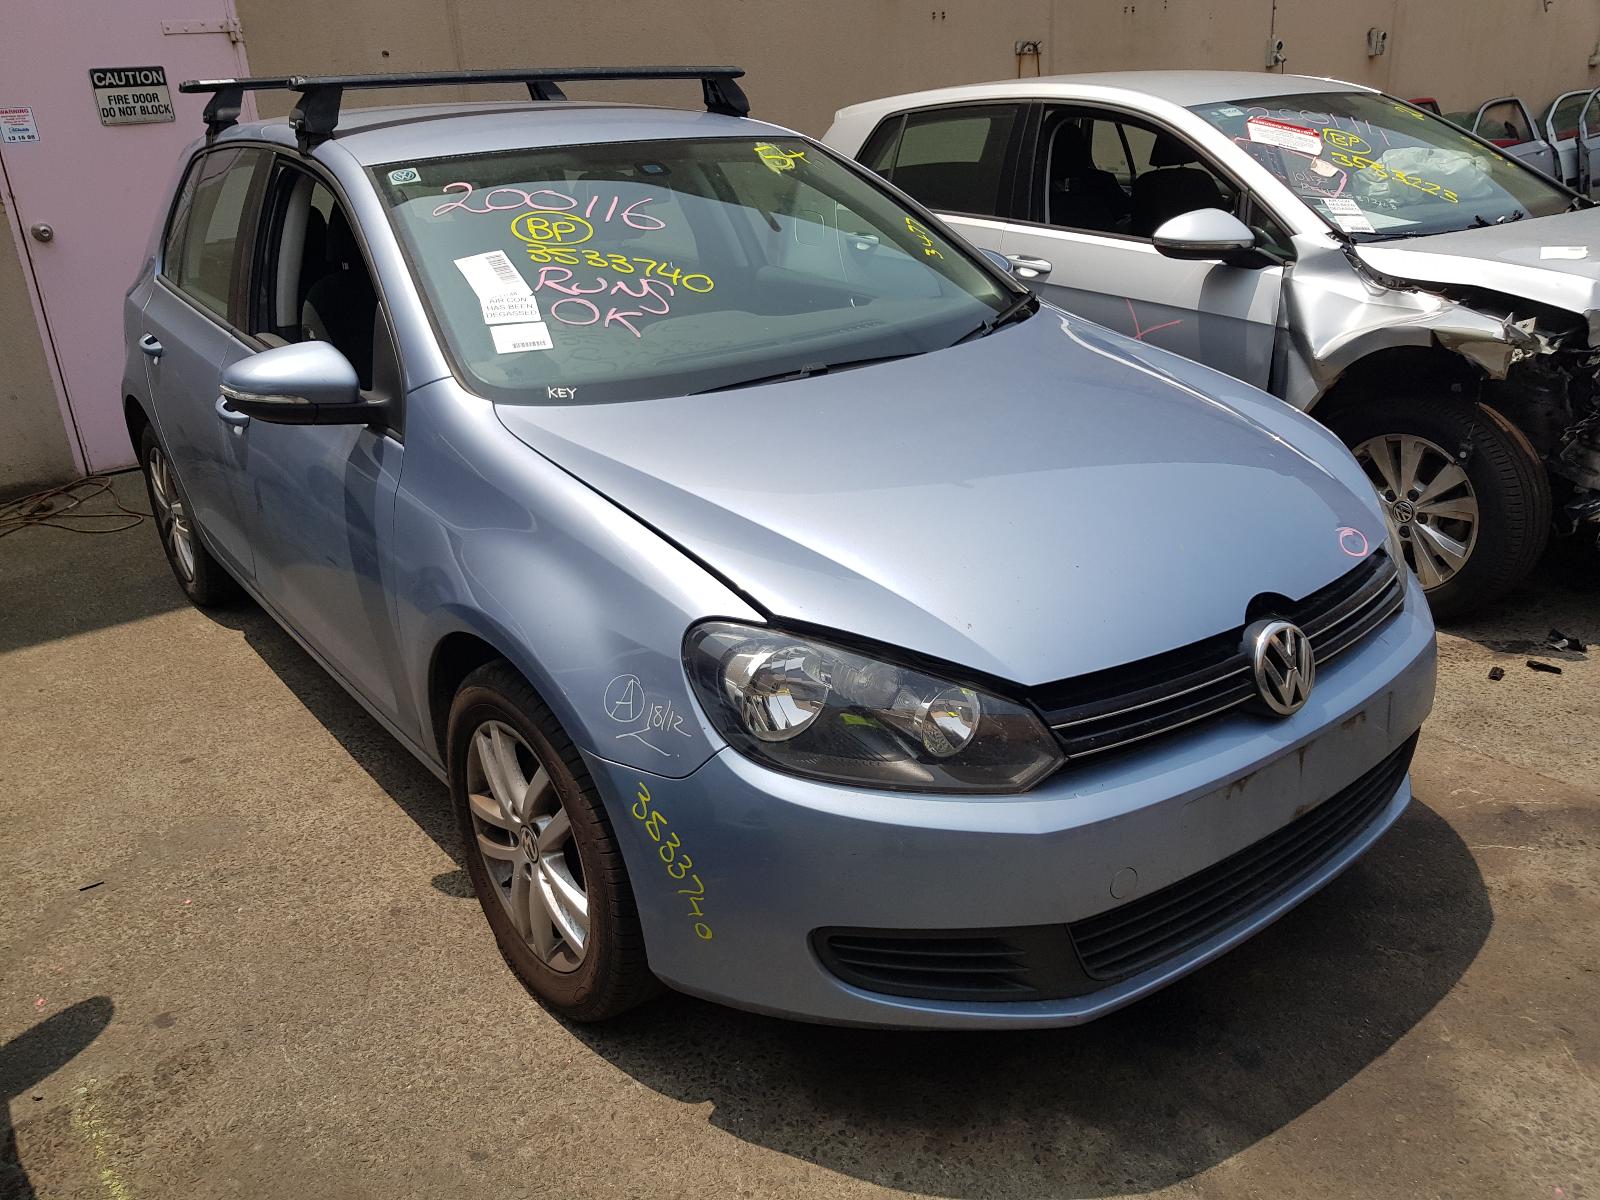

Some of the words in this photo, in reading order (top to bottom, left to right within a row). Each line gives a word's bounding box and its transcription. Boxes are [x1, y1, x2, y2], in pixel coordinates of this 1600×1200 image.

[93, 70, 165, 86] CAUTION
[107, 94, 131, 105] FIRE
[132, 92, 160, 104] DOOR
[101, 106, 117, 118] DO
[119, 105, 138, 117] NOT
[140, 104, 172, 115] BLOCK
[432, 182, 667, 230] 200116
[526, 217, 576, 242] BP
[526, 243, 715, 293] 3533740
[486, 310, 537, 319] DEGASSED
[551, 298, 644, 339] OK
[547, 386, 577, 400] KEY
